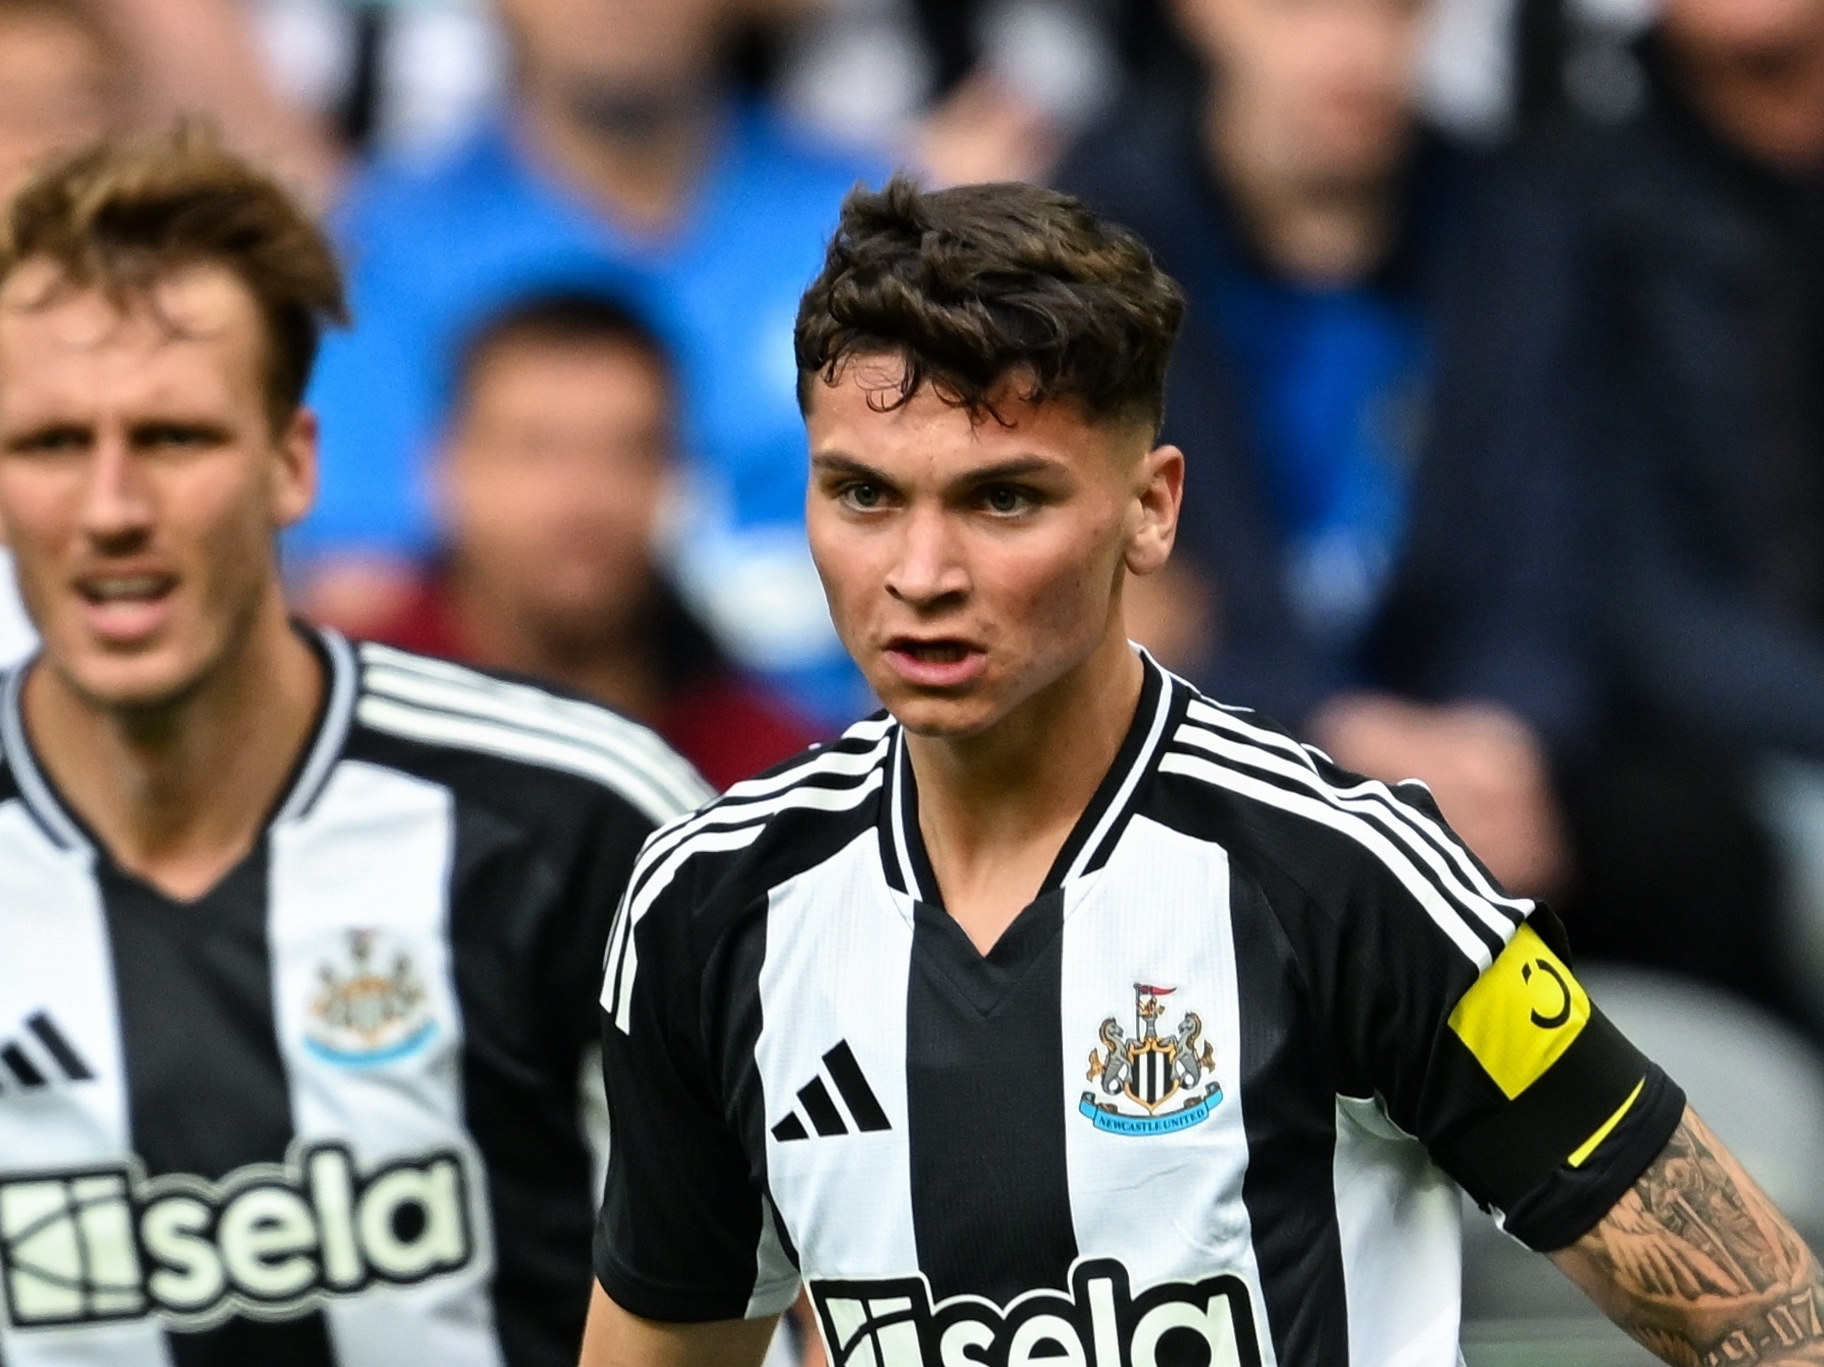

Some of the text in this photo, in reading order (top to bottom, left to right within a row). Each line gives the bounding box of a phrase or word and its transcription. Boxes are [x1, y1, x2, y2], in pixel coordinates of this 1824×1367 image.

[1099, 1109, 1205, 1132] NEWCASTLE UNITED
[140, 1148, 471, 1307] sela
